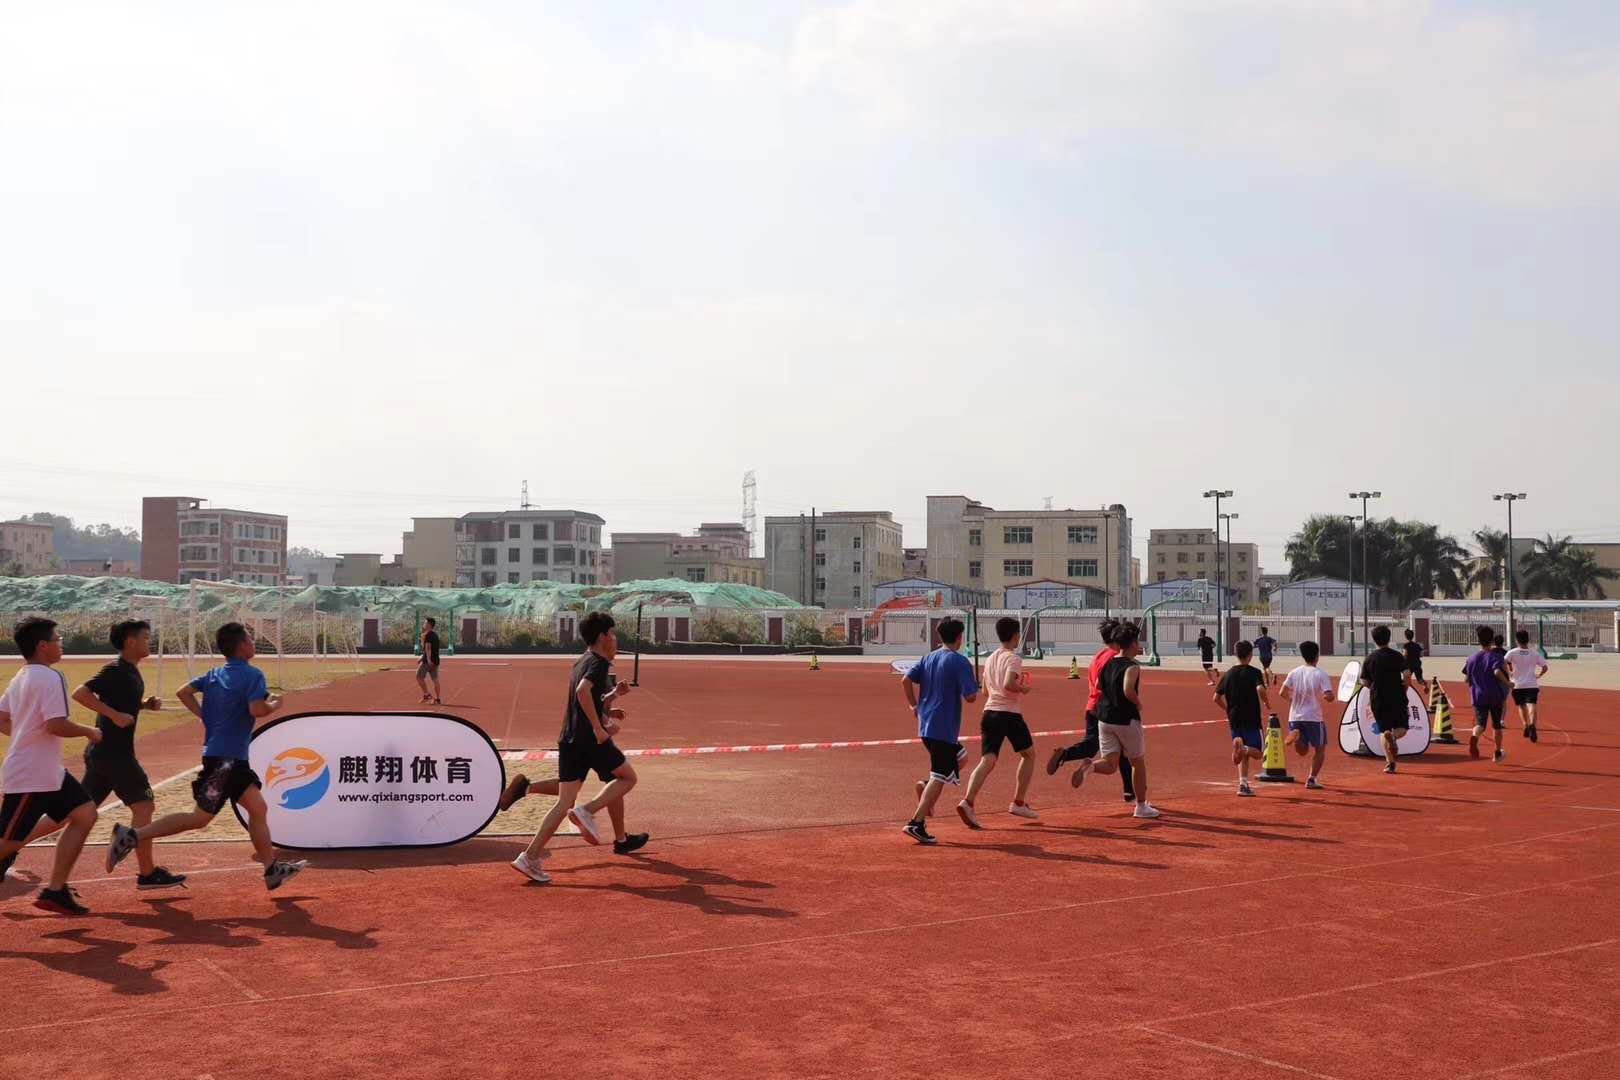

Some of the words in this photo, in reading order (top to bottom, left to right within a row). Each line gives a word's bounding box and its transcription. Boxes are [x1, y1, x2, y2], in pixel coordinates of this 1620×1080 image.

[338, 755, 473, 784] 麒翔体育
[338, 792, 474, 803] www.qixiangsport.com
